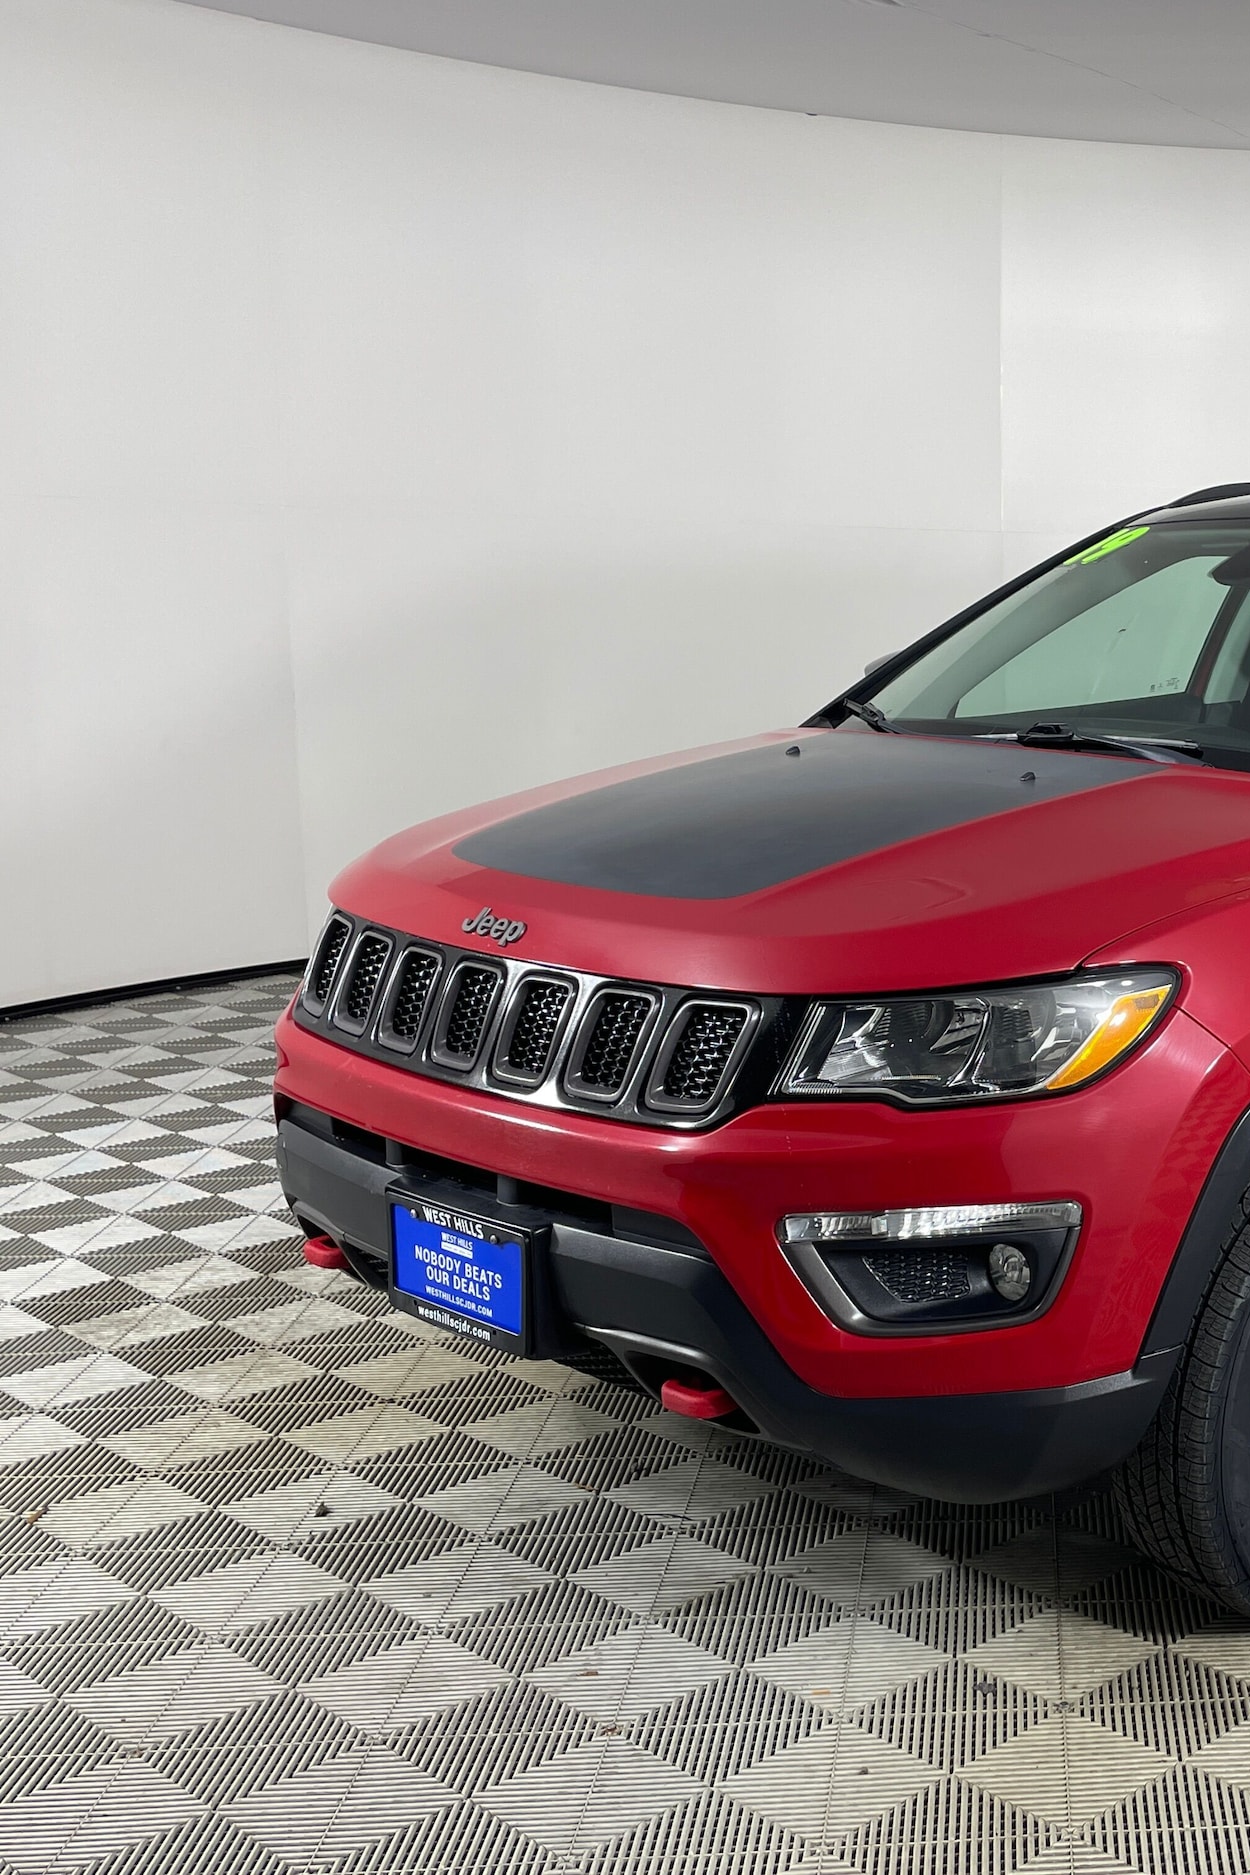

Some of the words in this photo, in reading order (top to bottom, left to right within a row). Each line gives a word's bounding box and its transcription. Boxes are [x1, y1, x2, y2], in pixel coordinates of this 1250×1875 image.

[462, 906, 526, 946] Jeep
[422, 1206, 452, 1228] WEST
[454, 1216, 484, 1240] HILLS
[441, 1232, 456, 1245] WEST
[457, 1236, 473, 1250] HILLS
[415, 1245, 461, 1273] NOBODY
[465, 1262, 503, 1289] BEATS
[426, 1266, 450, 1286] OUR
[453, 1275, 491, 1301] DEALS
[426, 1285, 493, 1318] WESTHILLSCJDR.COM
[418, 1305, 491, 1341] westhillscjdr.com
